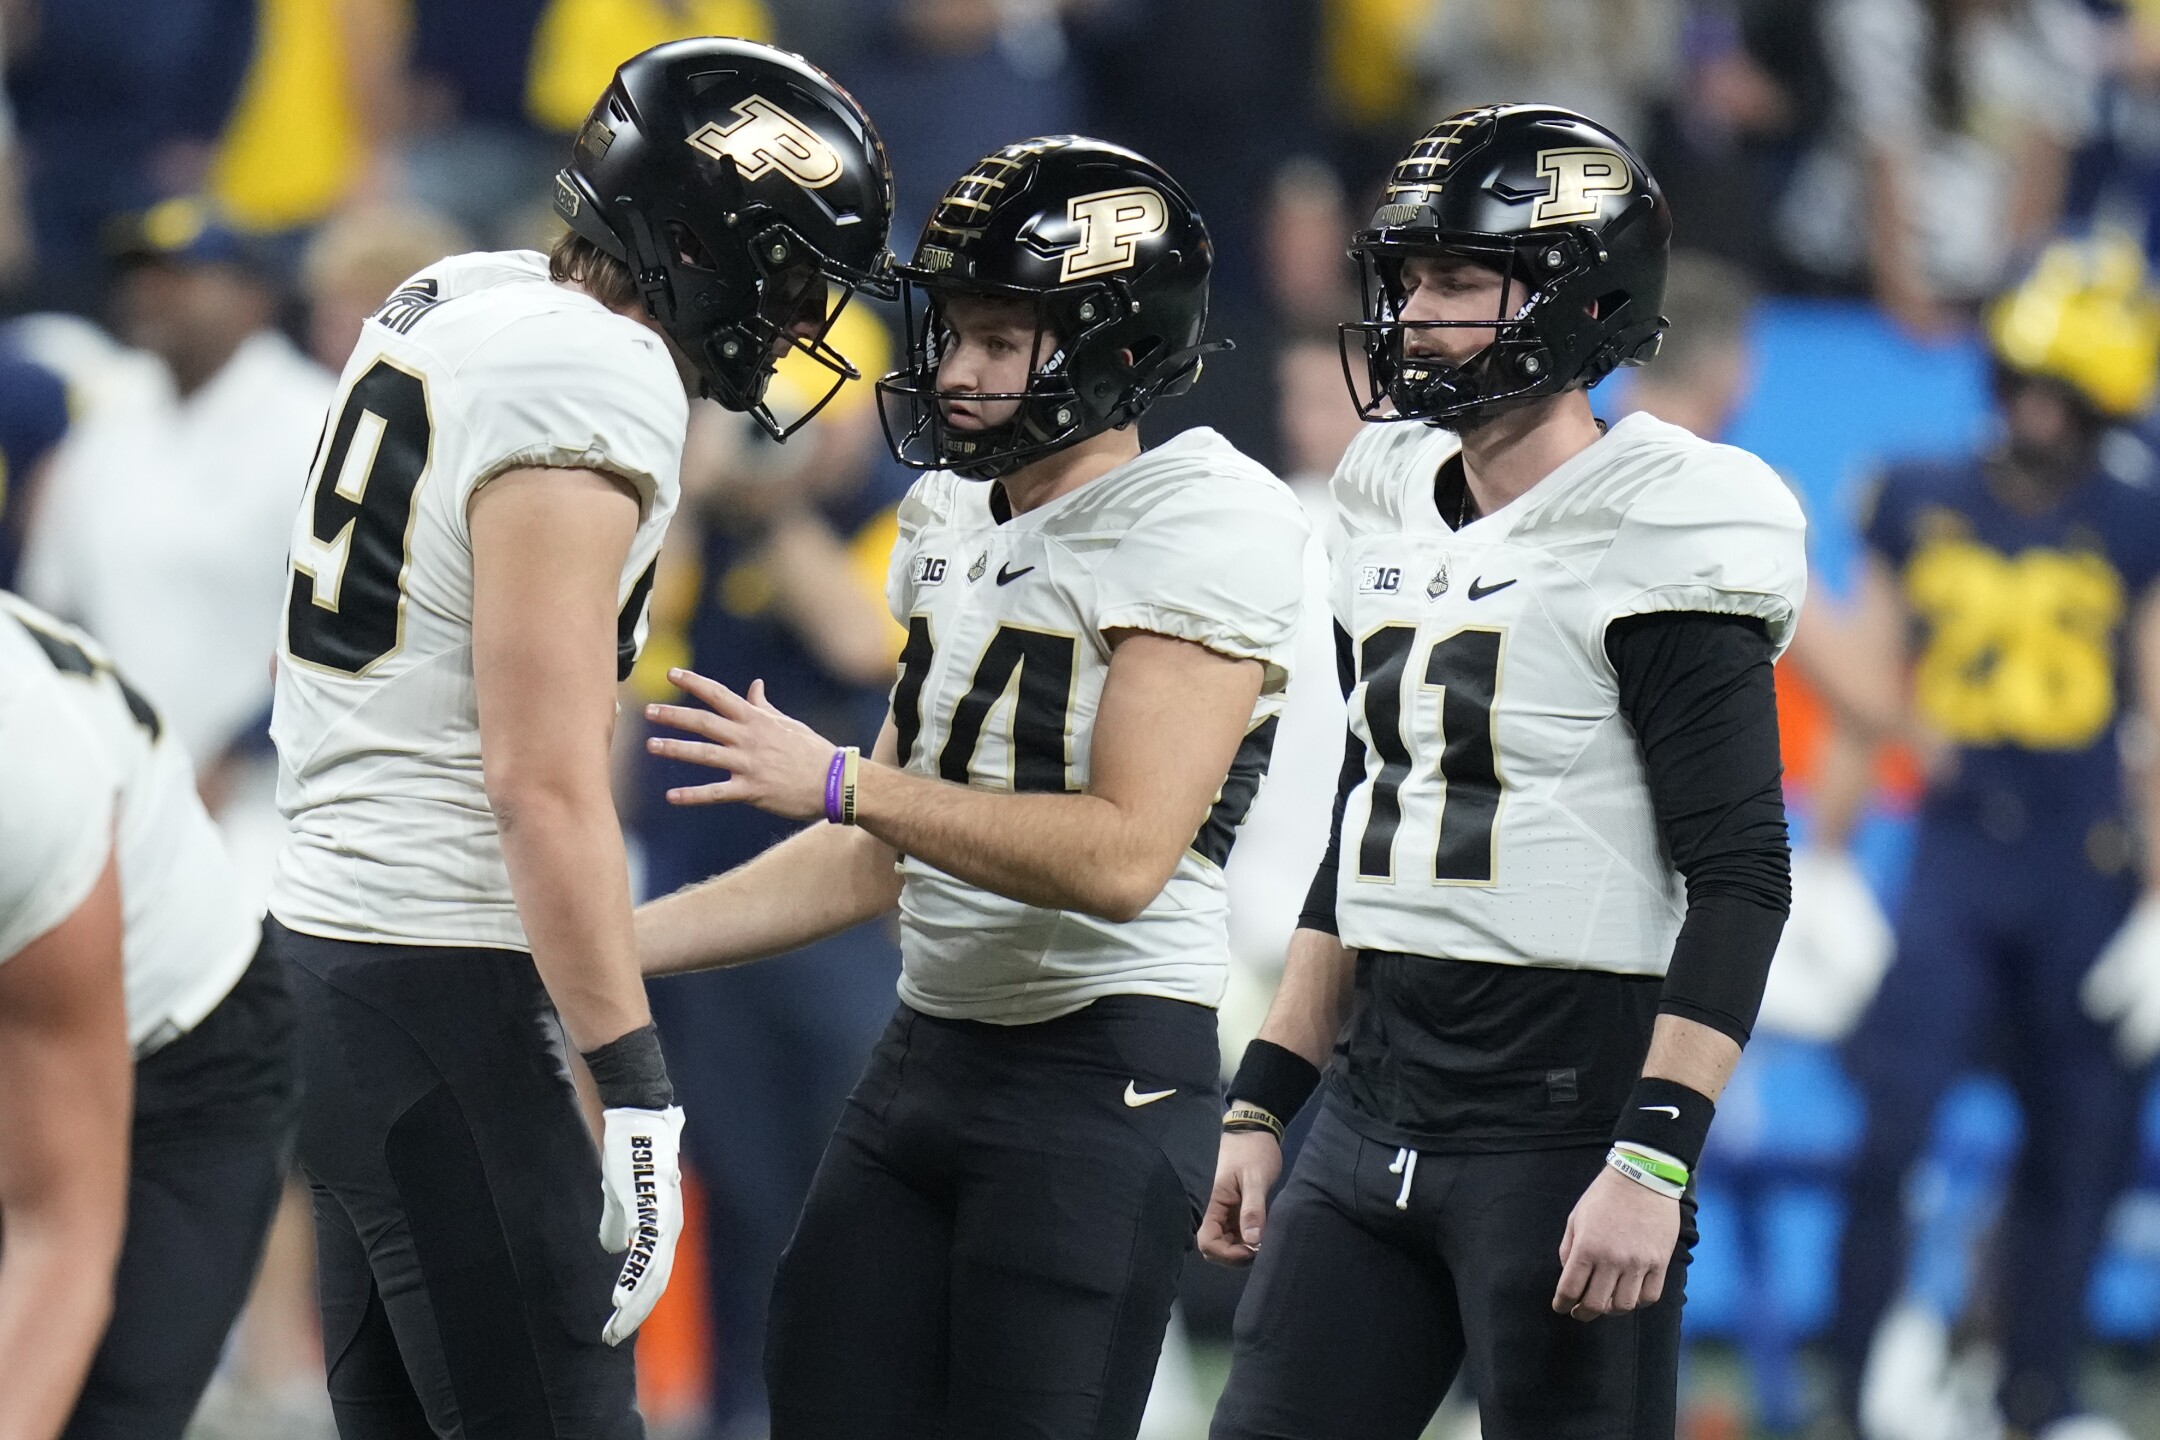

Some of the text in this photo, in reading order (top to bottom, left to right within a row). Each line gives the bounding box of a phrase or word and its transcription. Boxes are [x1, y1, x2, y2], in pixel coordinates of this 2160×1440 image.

[686, 94, 844, 189] P
[1530, 146, 1633, 228] P
[1060, 186, 1169, 283] P
[964, 441, 977, 454] UP
[282, 352, 434, 679] 9
[1356, 620, 1508, 887] 11
[617, 1136, 658, 1291] BOILERMAKERS
[1614, 1159, 1642, 1180] BOILER UP
